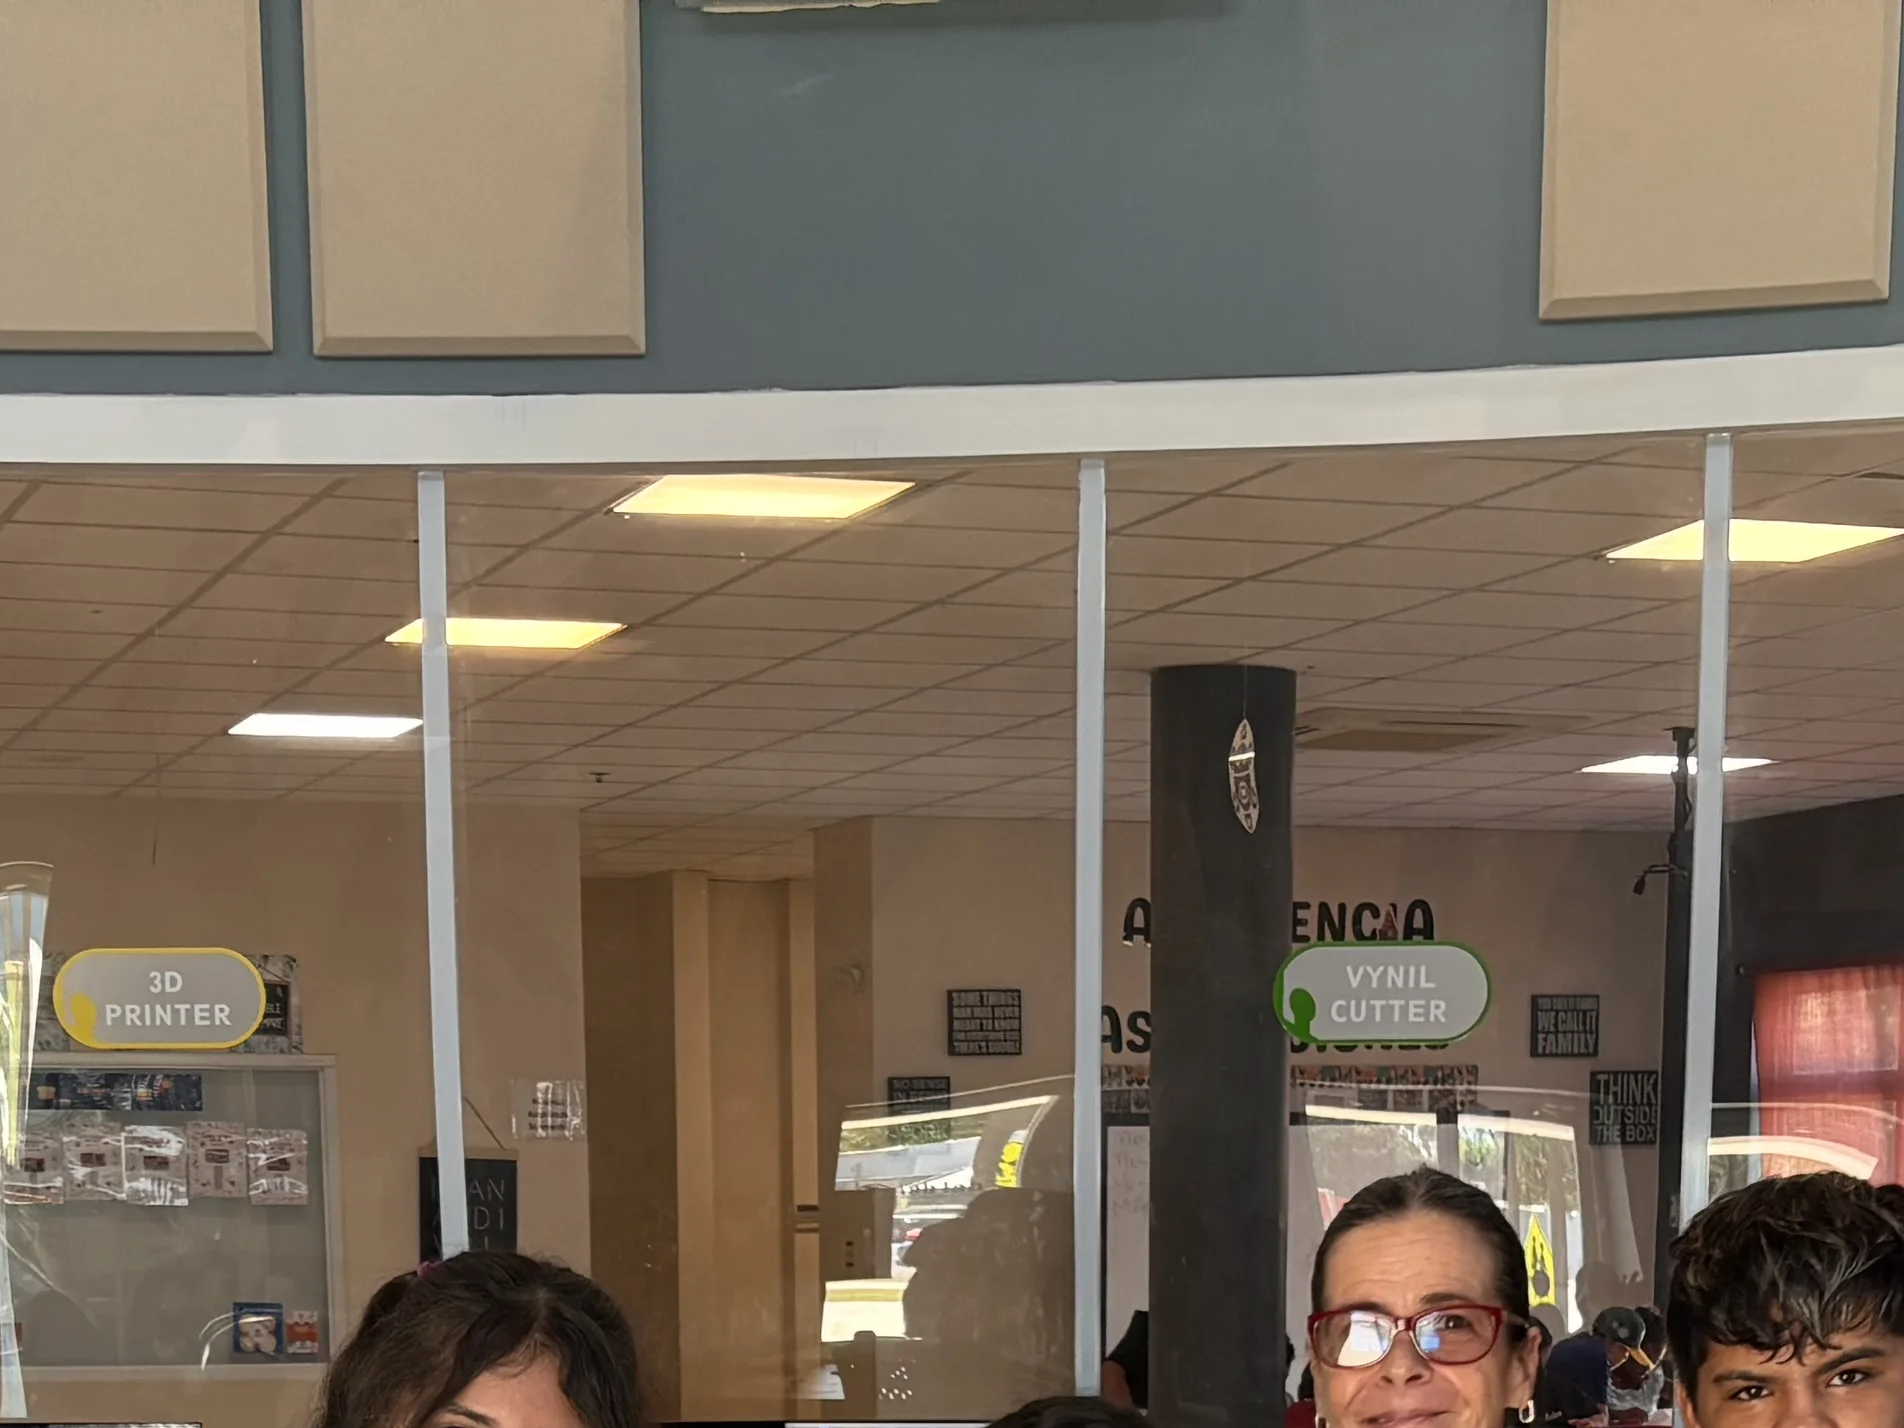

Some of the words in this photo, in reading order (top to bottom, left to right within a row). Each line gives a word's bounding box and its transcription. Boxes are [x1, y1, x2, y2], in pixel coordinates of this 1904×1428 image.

[149, 971, 183, 993] 3D
[1346, 965, 1436, 989] VYNIL
[105, 1004, 232, 1026] PRINTER
[1331, 999, 1447, 1023] CUTTER
[1537, 1011, 1556, 1031] WE
[1537, 1032, 1596, 1054] FAMILY
[1596, 1073, 1657, 1105] THINK
[1593, 1105, 1657, 1124] OUTSIDE
[1596, 1125, 1621, 1142] THE
[1625, 1125, 1656, 1142] BOX
